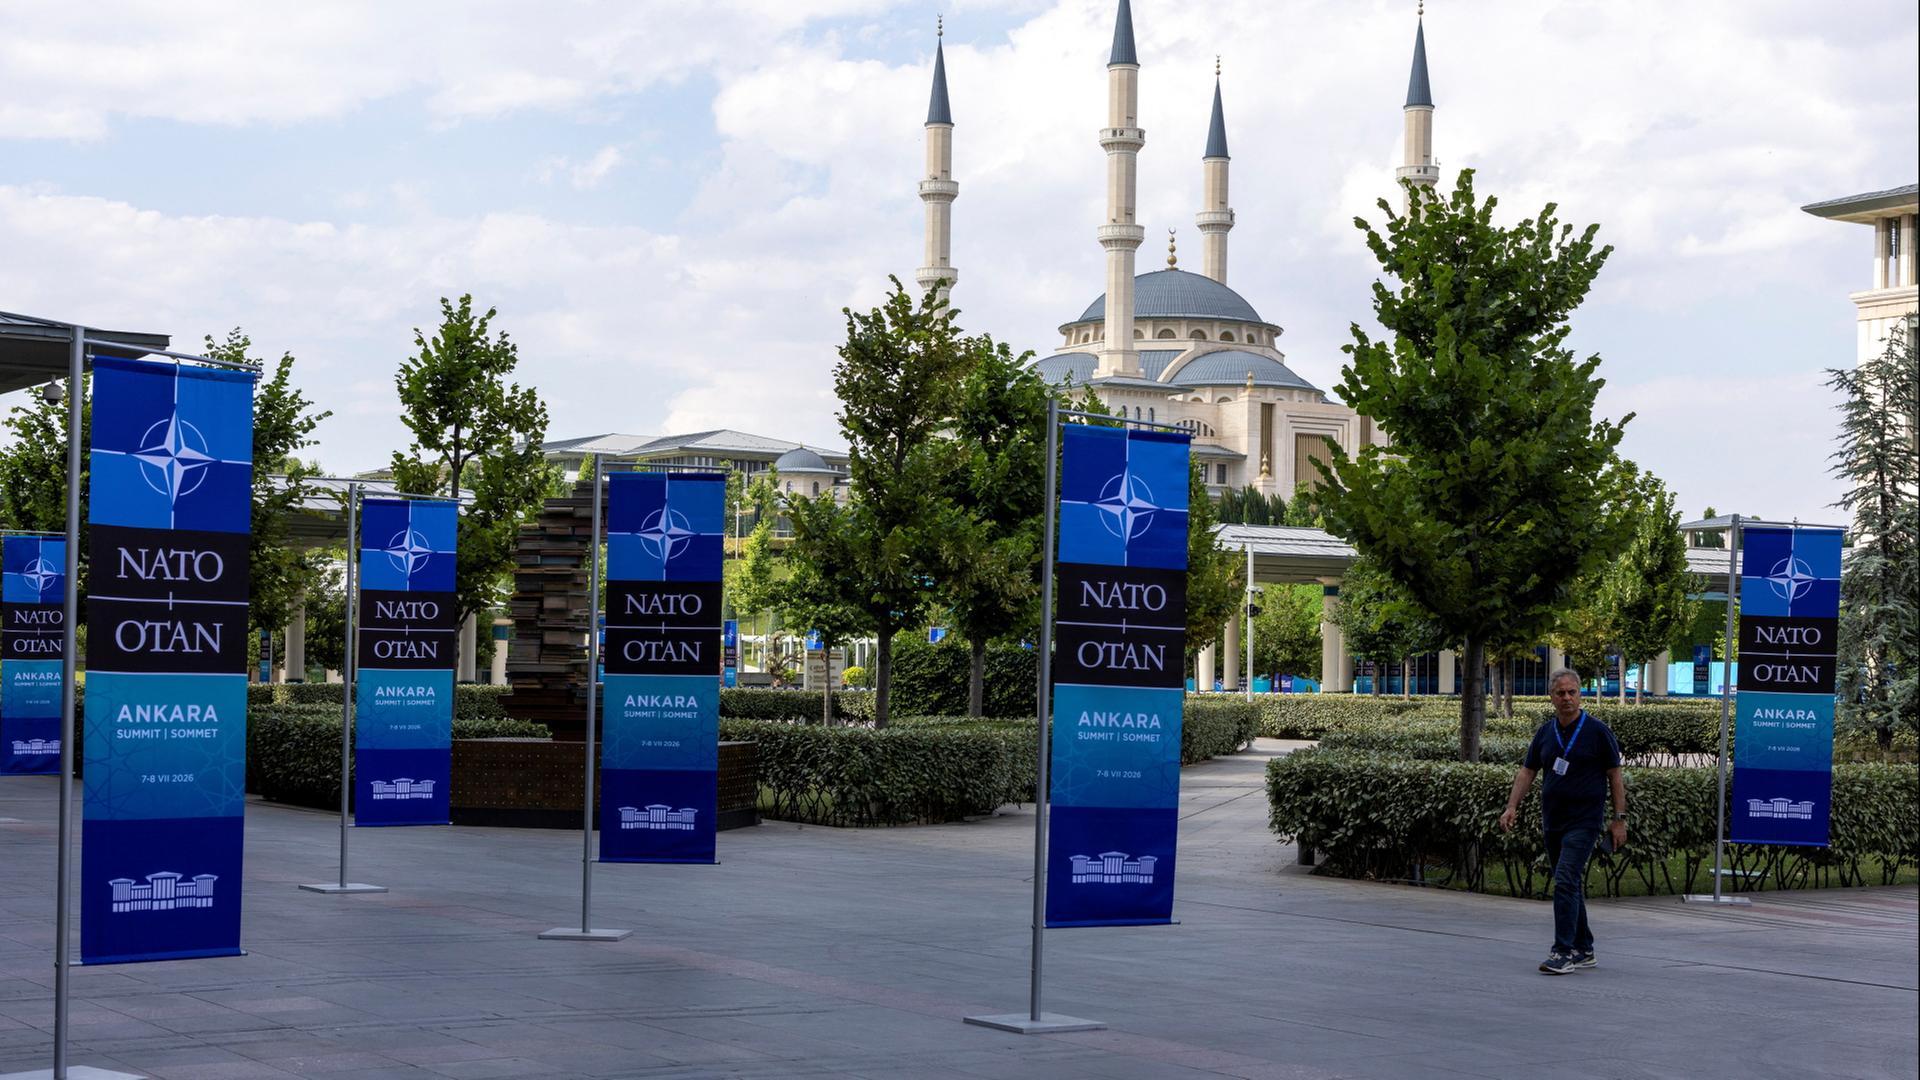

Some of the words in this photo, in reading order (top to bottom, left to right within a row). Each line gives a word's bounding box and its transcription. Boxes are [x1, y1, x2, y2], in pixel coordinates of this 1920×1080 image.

[117, 548, 223, 582] NATO
[1080, 581, 1166, 611] NATO
[376, 601, 438, 619] NATO
[625, 594, 702, 615] NATO
[15, 610, 63, 624] NATO
[116, 620, 223, 653] OTAN
[1755, 626, 1821, 645] NATO
[12, 638, 63, 653] OTAN
[374, 640, 438, 658] OTAN
[624, 641, 701, 662] OTAN
[1078, 641, 1165, 671] OTAN
[14, 671, 61, 681] ANKARA
[1754, 664, 1820, 683] OTAN
[375, 686, 436, 697] ANKARA
[624, 694, 698, 708] ANKARA
[117, 705, 218, 722] ANKARA
[623, 710, 657, 718] SUMMIT
[662, 711, 698, 719] SOMMET
[1078, 711, 1160, 728] ANKARA
[1753, 707, 1817, 721] ANKARA
[1752, 720, 1781, 728] SUMMIT
[116, 728, 162, 739] SUMMIT
[170, 728, 219, 739] SOMMET
[1077, 731, 1115, 741] SUMMIT
[1122, 732, 1161, 743] SOMMET
[141, 774, 156, 784] 7-8
[157, 774, 170, 783] VII
[171, 773, 194, 783] 2026
[1110, 770, 1122, 778] VII
[1122, 770, 1142, 779] 2026
